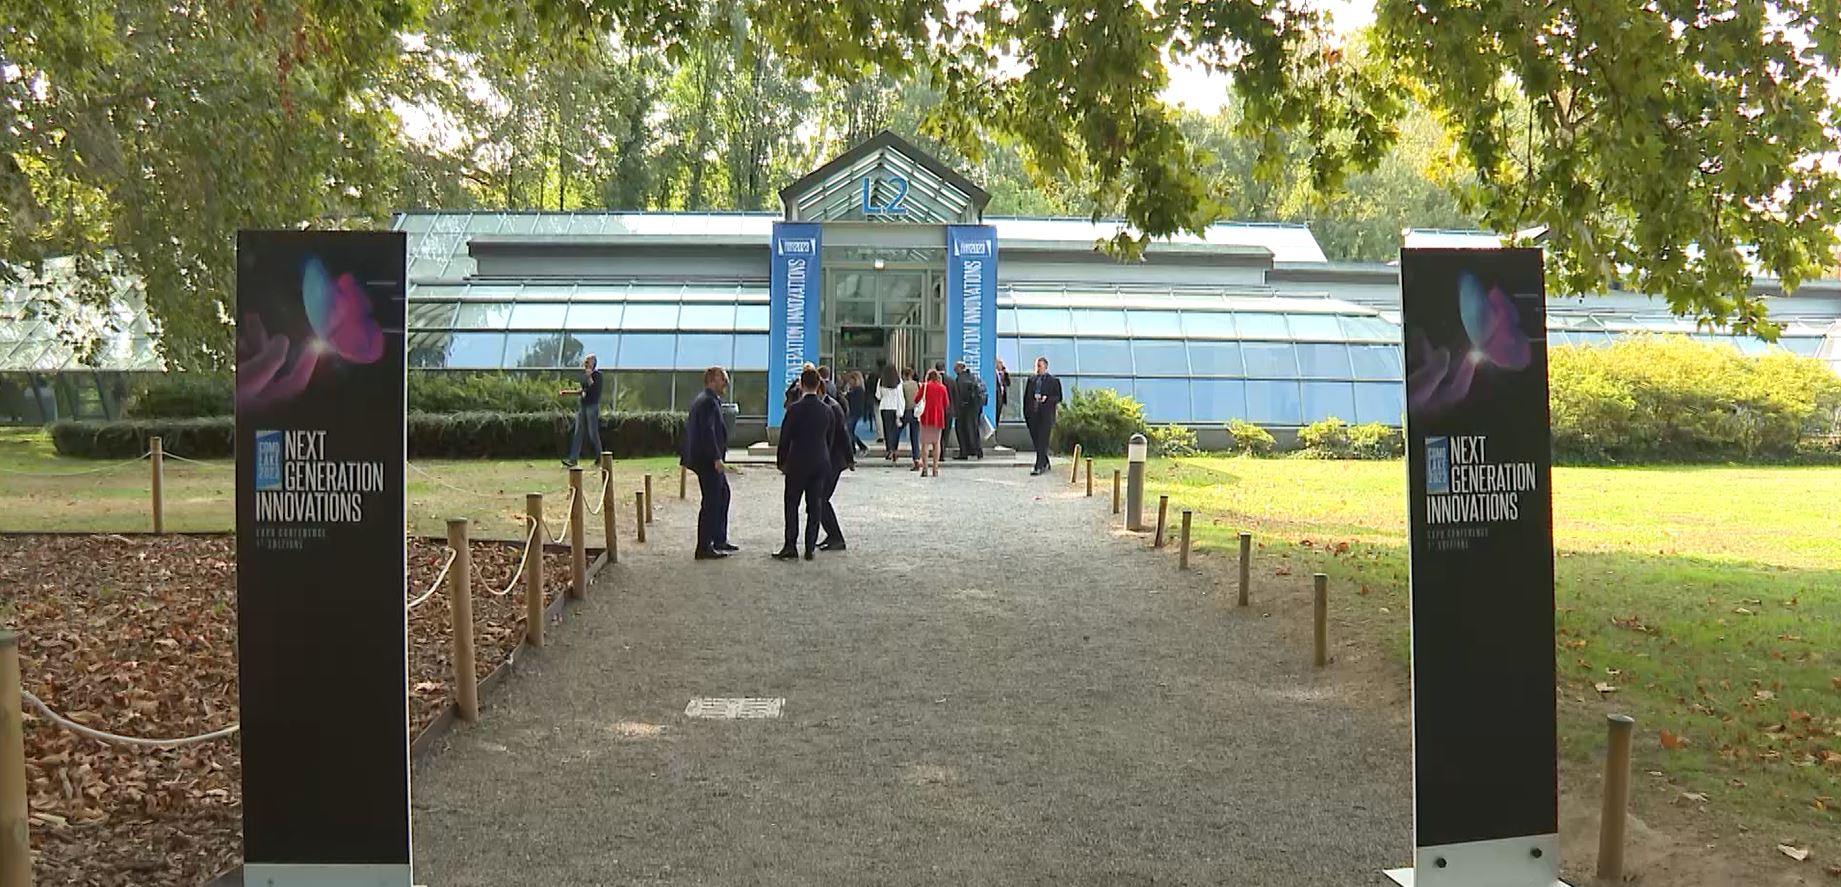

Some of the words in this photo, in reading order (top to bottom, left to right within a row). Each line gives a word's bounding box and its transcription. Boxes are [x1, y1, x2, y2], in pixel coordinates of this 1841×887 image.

[864, 176, 909, 215] L2
[786, 259, 806, 323] INNOVATIONS
[963, 260, 982, 323] INNOVATIONS
[284, 430, 327, 460] NEXT
[1450, 435, 1486, 464] NEXT
[285, 461, 384, 491] GENERATION
[1451, 462, 1536, 493] GENERATION
[256, 492, 362, 521] INNOVATIONS
[1427, 492, 1519, 524] INNOVATIONS
